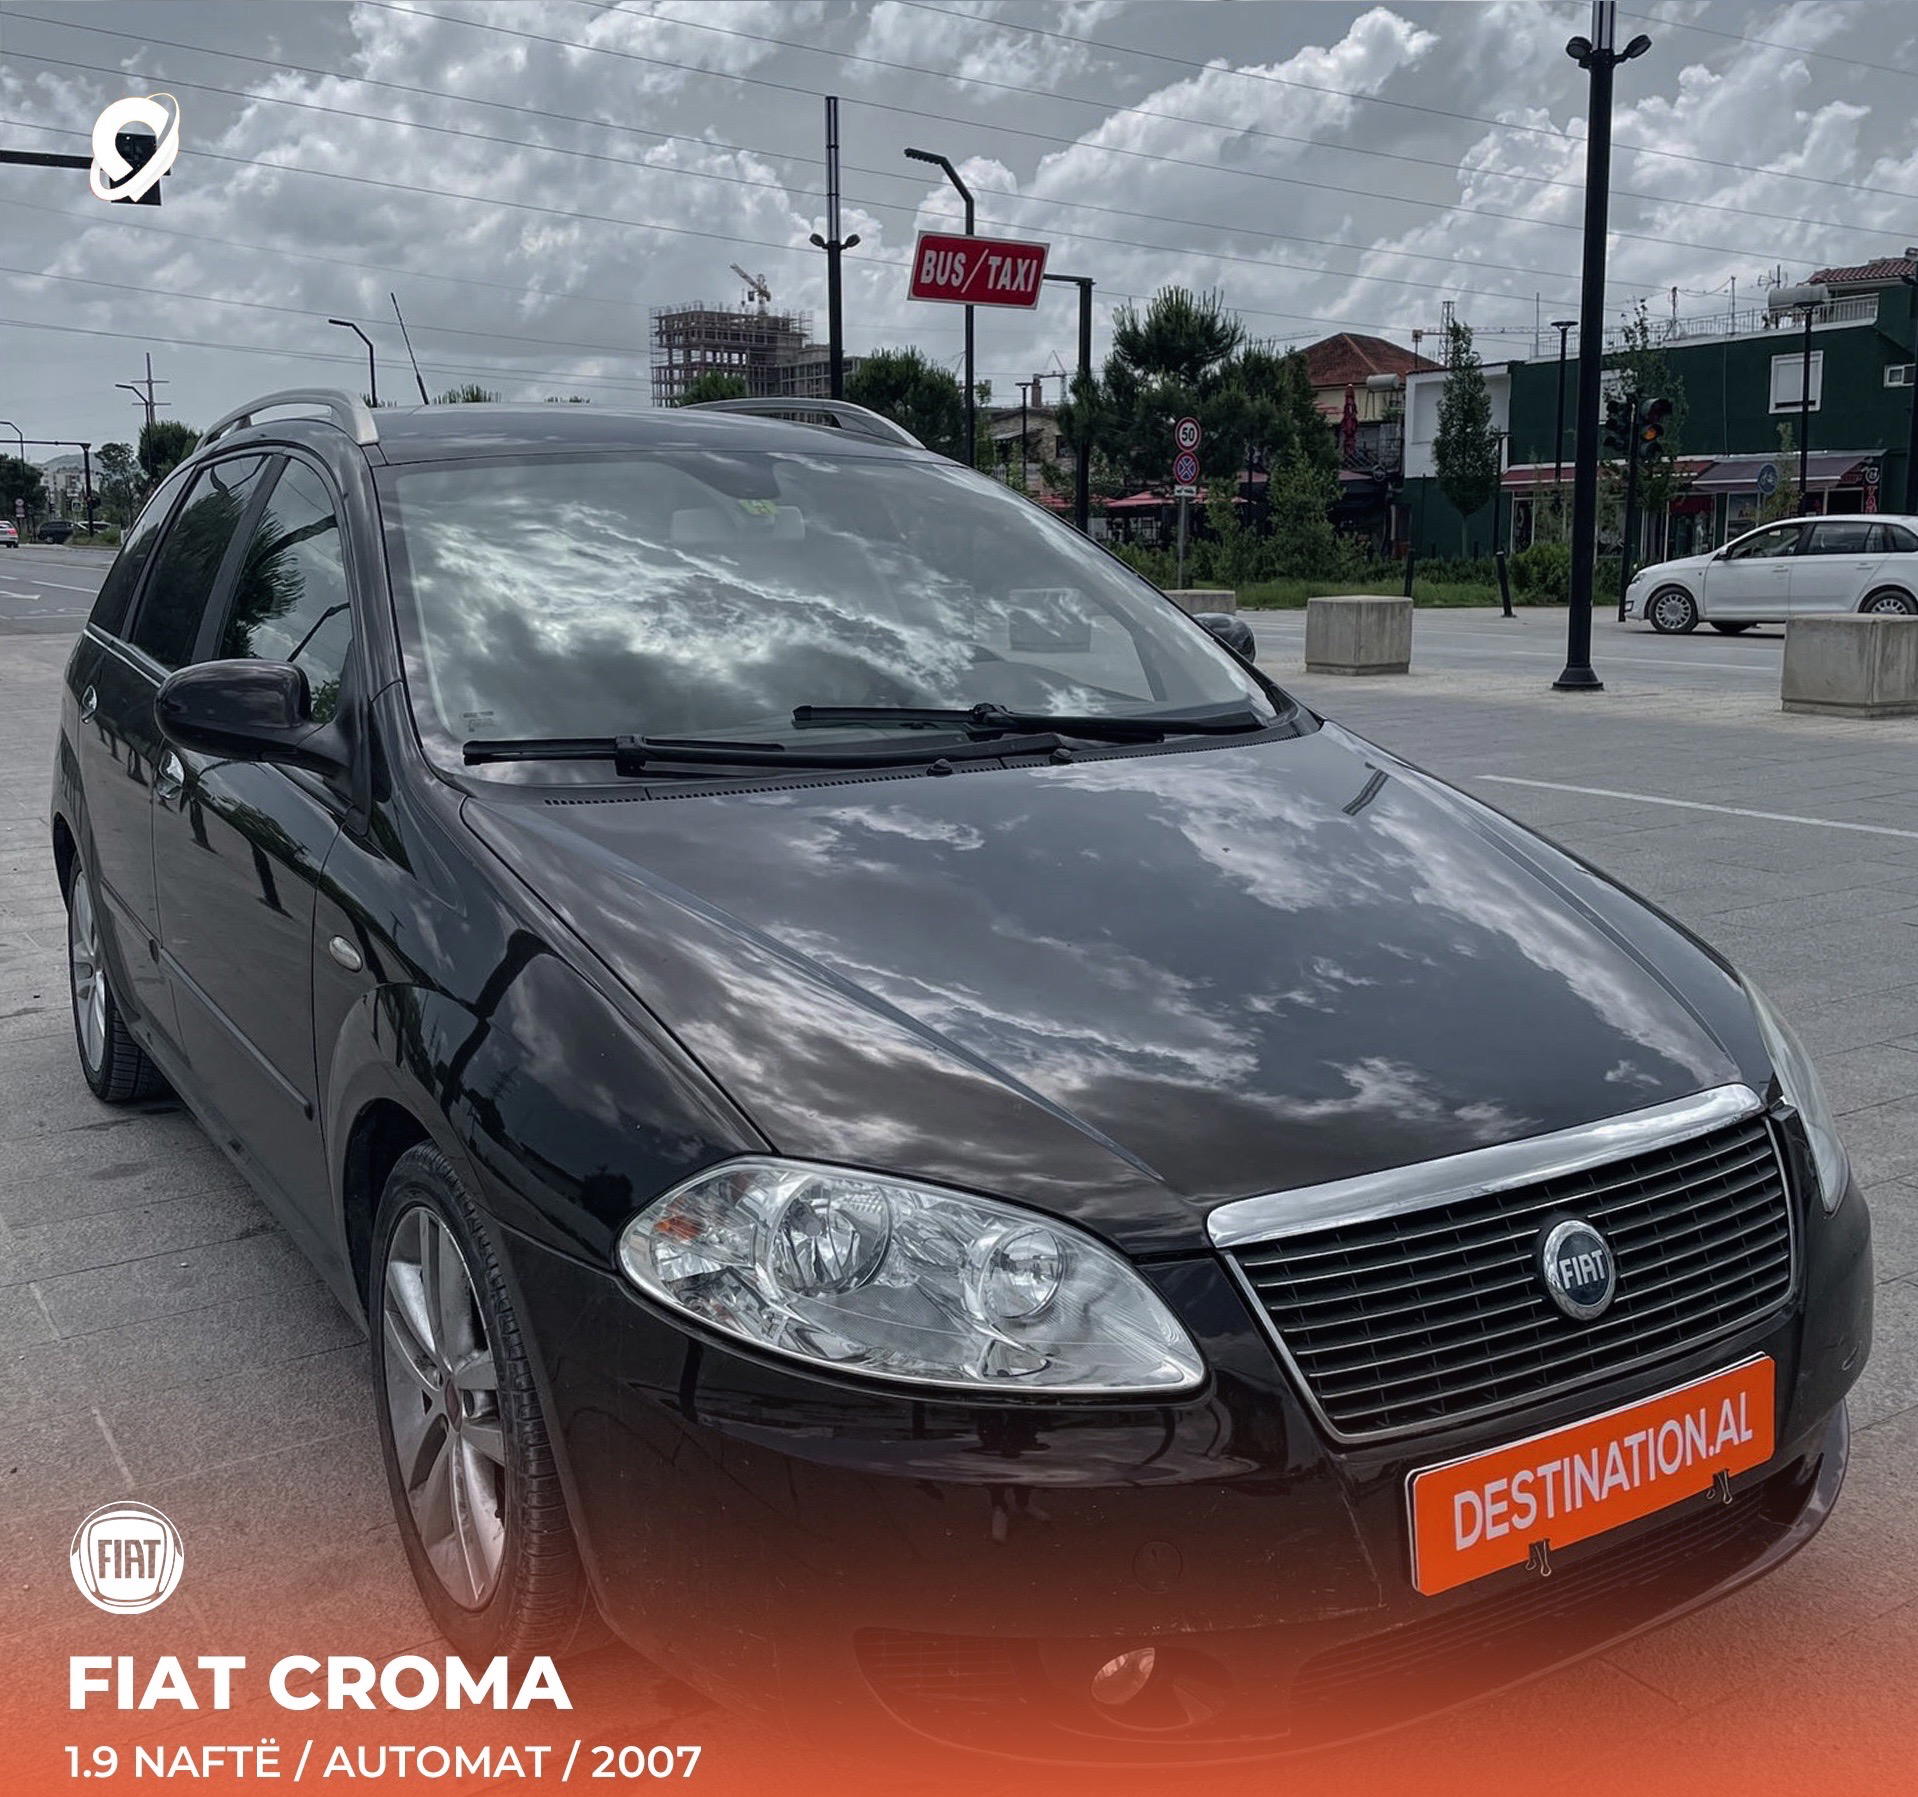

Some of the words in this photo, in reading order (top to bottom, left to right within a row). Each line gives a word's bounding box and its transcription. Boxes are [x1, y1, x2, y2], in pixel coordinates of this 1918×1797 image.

[920, 248, 1037, 293] BUS/TAXI
[1181, 427, 1195, 442] 50
[1559, 1249, 1605, 1290] FIAT
[1453, 1391, 1753, 1551] DESTINATION.AL
